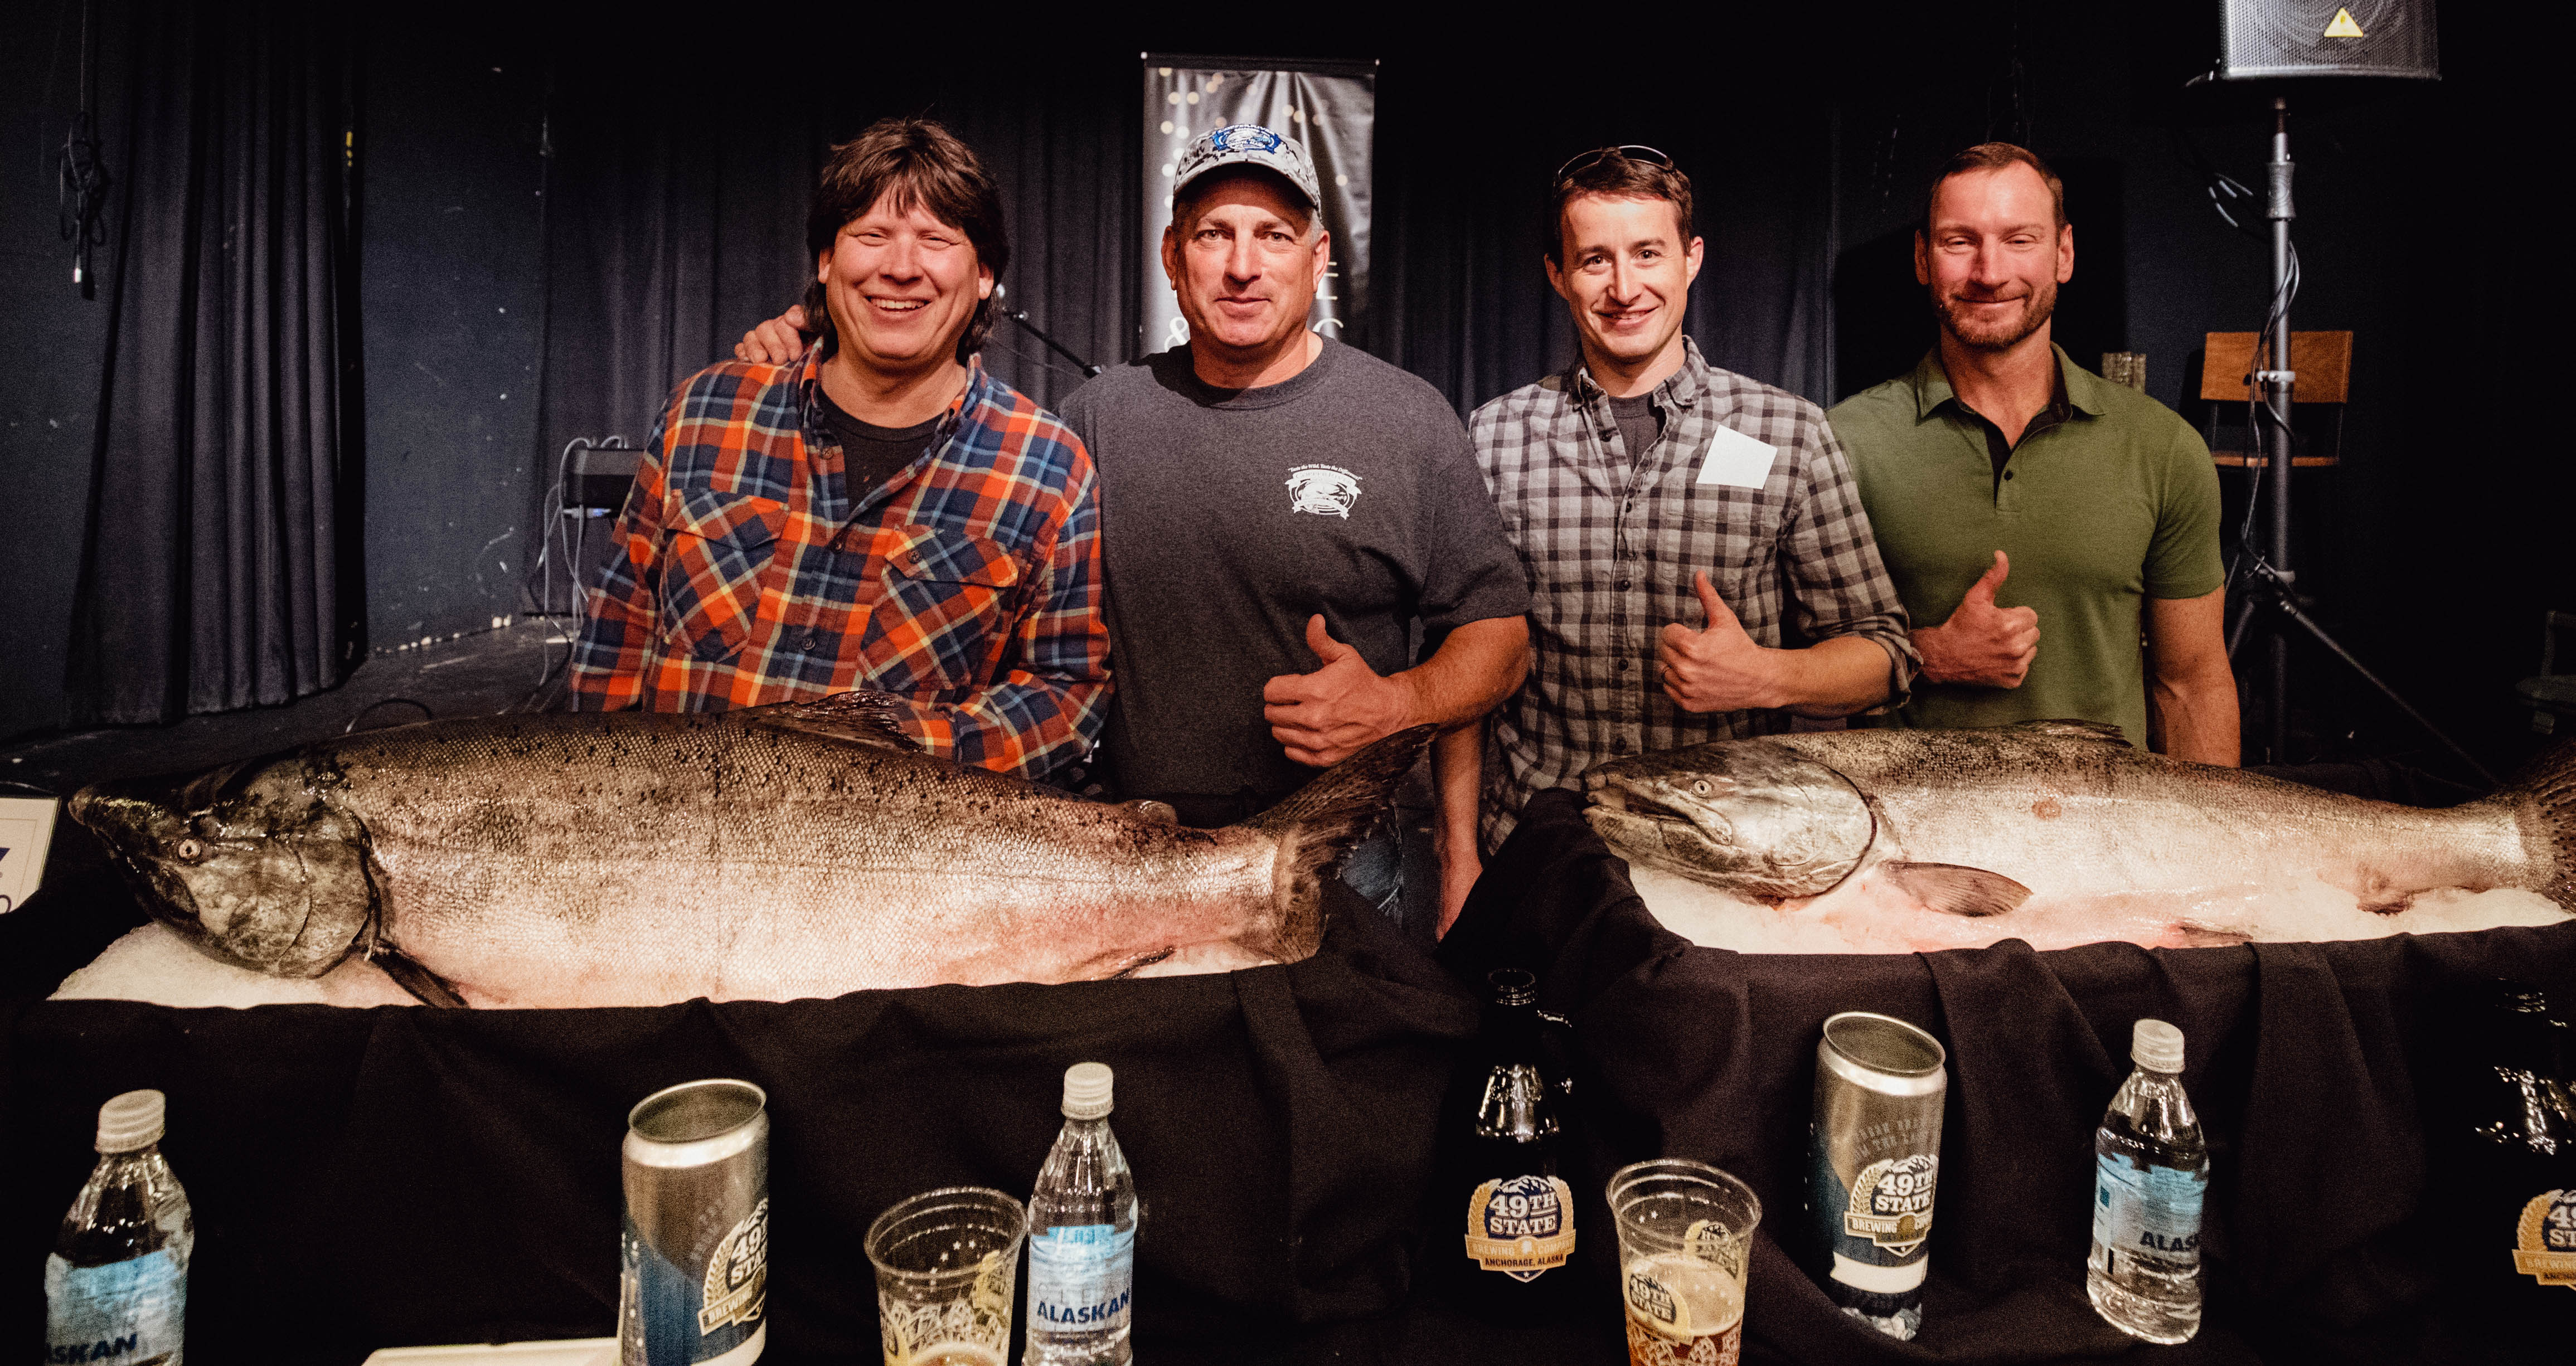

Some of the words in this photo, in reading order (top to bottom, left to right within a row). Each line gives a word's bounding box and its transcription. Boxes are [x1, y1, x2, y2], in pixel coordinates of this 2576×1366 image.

[1878, 1170, 1933, 1197] 49TH
[1489, 1192, 1558, 1218] 49TH
[1875, 1190, 1931, 1212] STATE
[1490, 1214, 1557, 1235] STATE
[1852, 1217, 1898, 1233] BREWING
[1485, 1257, 1535, 1267] ANCHORAGE,
[1537, 1254, 1563, 1266] ALASKA
[707, 1286, 754, 1325] BREWING
[1037, 1288, 1129, 1324] ALASKAN
